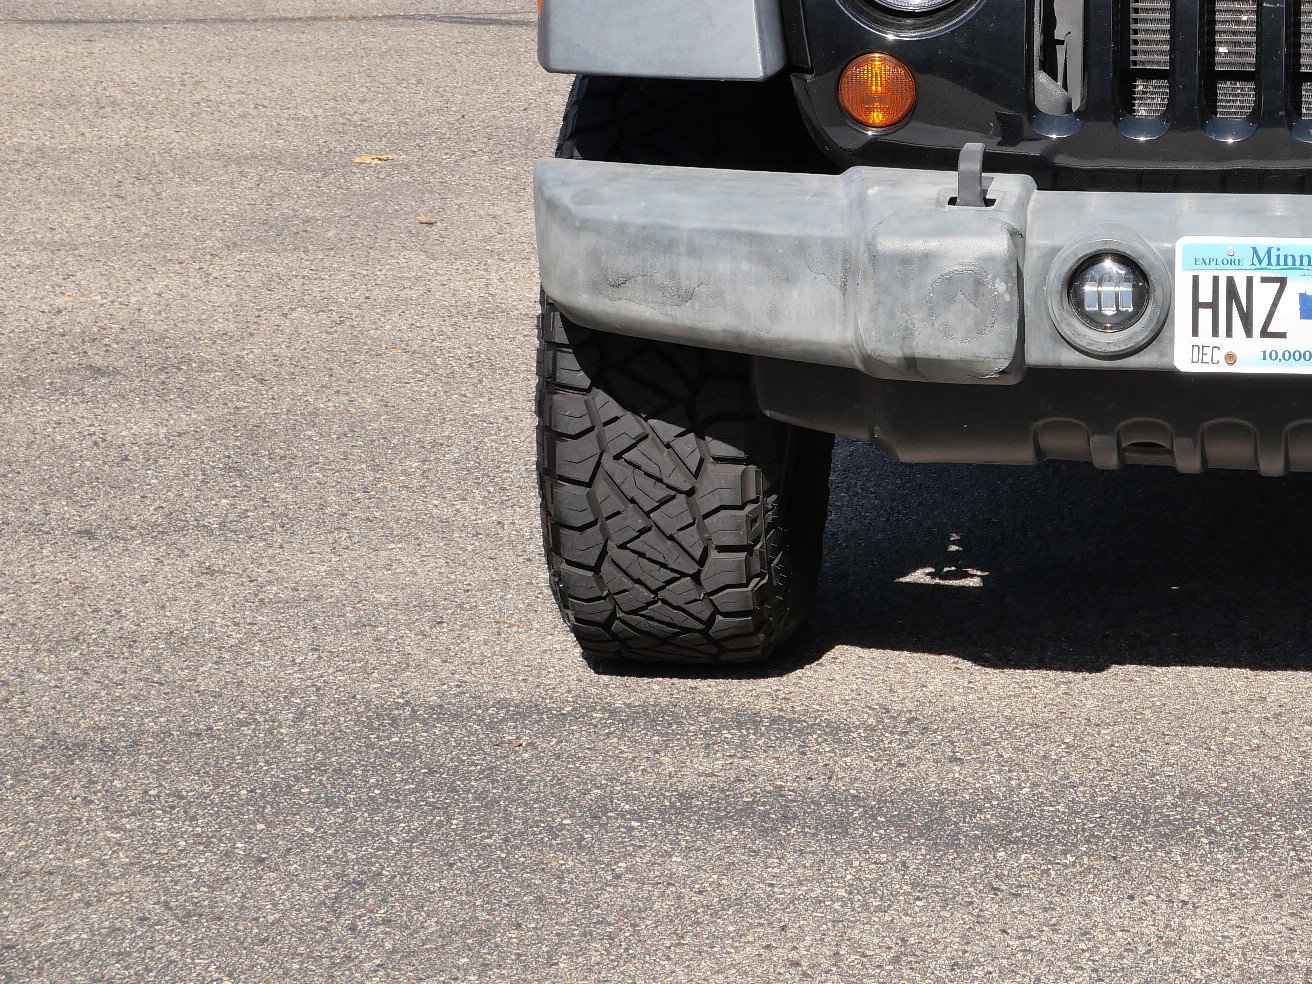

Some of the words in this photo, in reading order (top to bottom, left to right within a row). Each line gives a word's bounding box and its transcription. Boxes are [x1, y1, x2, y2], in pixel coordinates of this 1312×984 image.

[1194, 256, 1244, 267] EXPLORE
[1191, 274, 1288, 339] HNZ
[1190, 344, 1221, 365] DEC
[1259, 349, 1312, 364] 10,000
